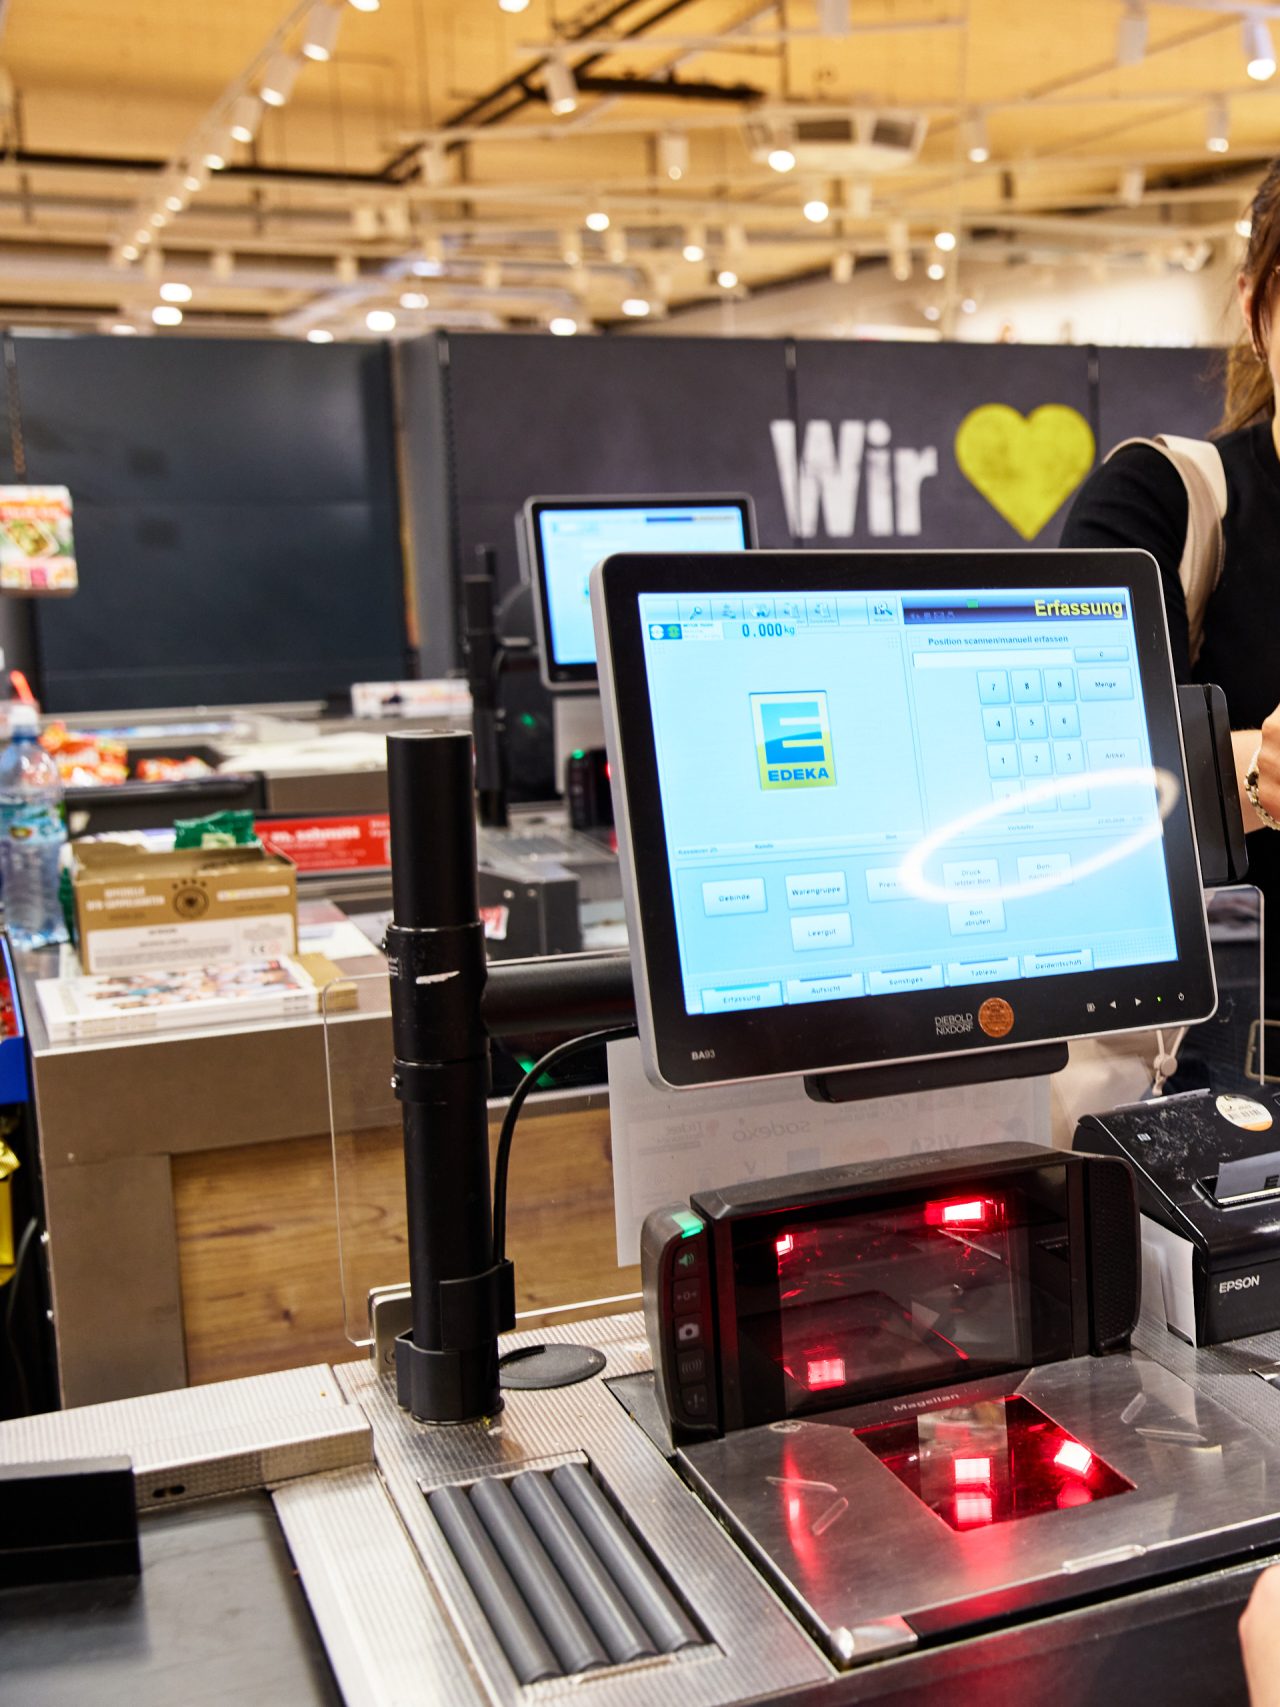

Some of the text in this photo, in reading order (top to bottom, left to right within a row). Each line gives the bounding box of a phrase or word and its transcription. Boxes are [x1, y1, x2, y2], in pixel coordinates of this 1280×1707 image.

[769, 419, 939, 538] Wir
[1034, 598, 1124, 619] Erfassung
[741, 622, 783, 638] 0.000
[784, 625, 796, 636] kg
[928, 637, 962, 647] Position
[1034, 634, 1069, 644] erfassen
[1094, 680, 1116, 689] Menge
[768, 767, 830, 782] EDEKA
[791, 885, 842, 897] Warengruppe
[718, 893, 751, 903] Gebinde
[964, 918, 991, 927] abrufen
[807, 928, 836, 937] Leergut
[971, 968, 998, 977] Tableau
[889, 975, 924, 986] Sonstiges
[811, 985, 841, 995] Aufsicht
[723, 993, 761, 1004] Erfassung
[934, 1012, 973, 1026] DIEBOLD
[936, 1021, 974, 1036] NIXDORF
[691, 1049, 716, 1061] BA93
[1219, 1274, 1260, 1294] EPSON
[893, 1393, 960, 1412] Magellan
